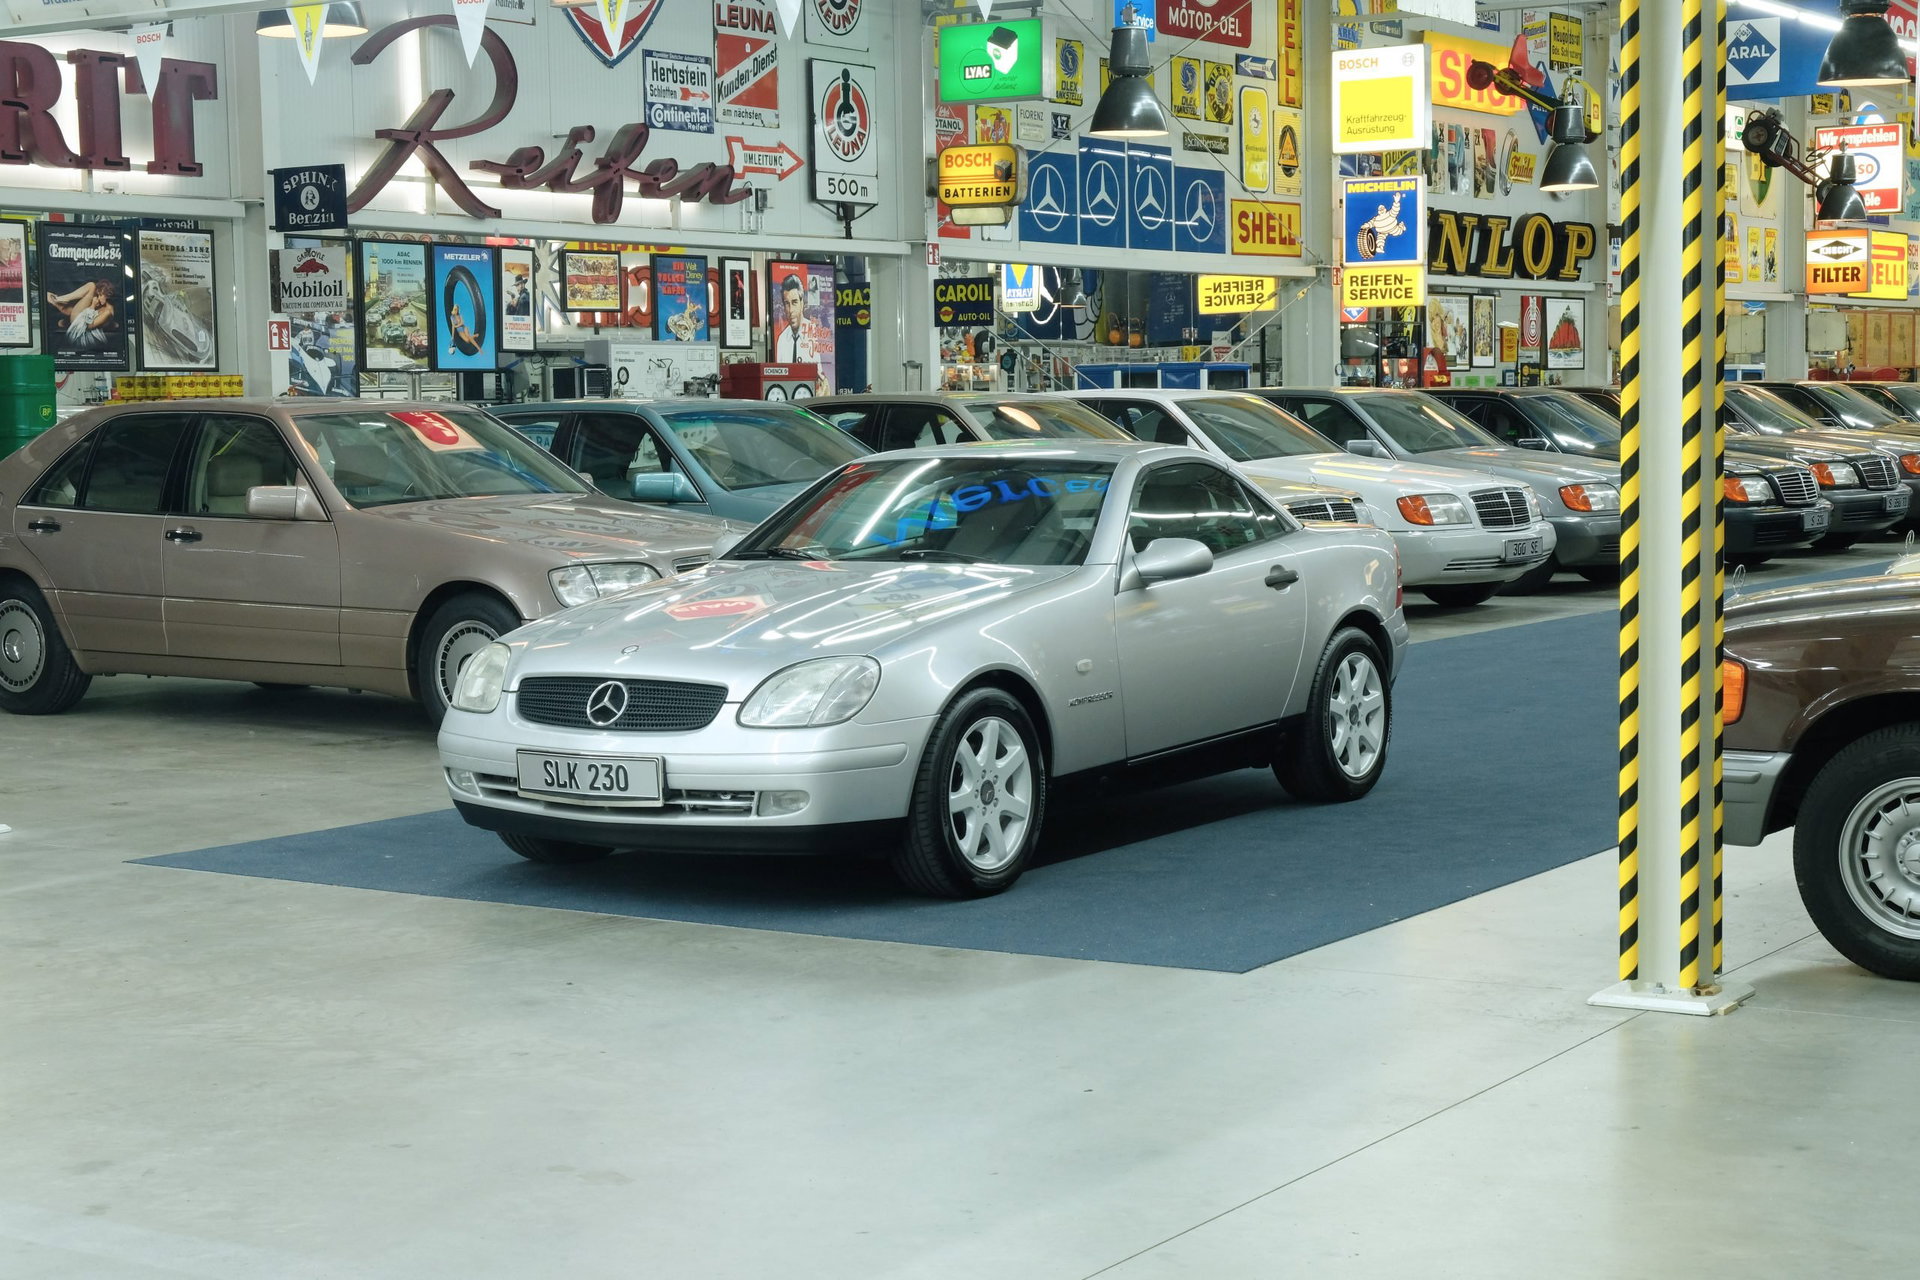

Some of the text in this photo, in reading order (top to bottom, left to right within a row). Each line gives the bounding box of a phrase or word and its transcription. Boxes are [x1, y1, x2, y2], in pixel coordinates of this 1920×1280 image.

[715, 3, 777, 35] LEUNA
[818, 0, 859, 30] LEUNA
[1168, 6, 1242, 37] MOTOR-OEL
[136, 33, 161, 44] BOSCH
[1728, 44, 1770, 60] ARAL
[1339, 58, 1379, 70] BOSCH
[651, 60, 707, 87] Herbstein
[717, 43, 778, 103] Kunden-Dienst
[965, 66, 990, 79] LYAC
[1056, 91, 1082, 101] ANKSTELLE
[345, 14, 753, 224] Reifen
[650, 103, 710, 128] Continental
[722, 108, 763, 121] am nächsten
[1020, 109, 1044, 121] FLORENZ
[1056, 115, 1068, 129] 17
[687, 122, 708, 132] Reifen
[827, 127, 867, 157] LEUNA
[1819, 131, 1838, 148] Wir
[743, 152, 784, 168] UMLEITUNG
[944, 153, 992, 169] BOSCH
[827, 177, 868, 198] 500 m
[944, 186, 1011, 198] BATTERIEN
[1347, 180, 1416, 193] MICHELIN
[288, 208, 336, 225] Benzin
[1237, 210, 1296, 246] SHELL
[49, 243, 109, 262] Emmanuelle
[1428, 208, 1596, 281] NLOP
[1908, 243, 1919, 257] SCH
[443, 253, 481, 261] METZELER
[1350, 274, 1412, 287] REIFEN-
[1813, 266, 1861, 284] FILTER
[1871, 263, 1905, 287] ELLI
[280, 280, 343, 299] Mobiloil
[935, 284, 992, 302] CAROIL
[1350, 287, 1413, 300] SERVICE
[958, 313, 991, 321] AUTO-OIL
[1513, 540, 1538, 556] 300 SE
[543, 759, 629, 792] SLK 230
